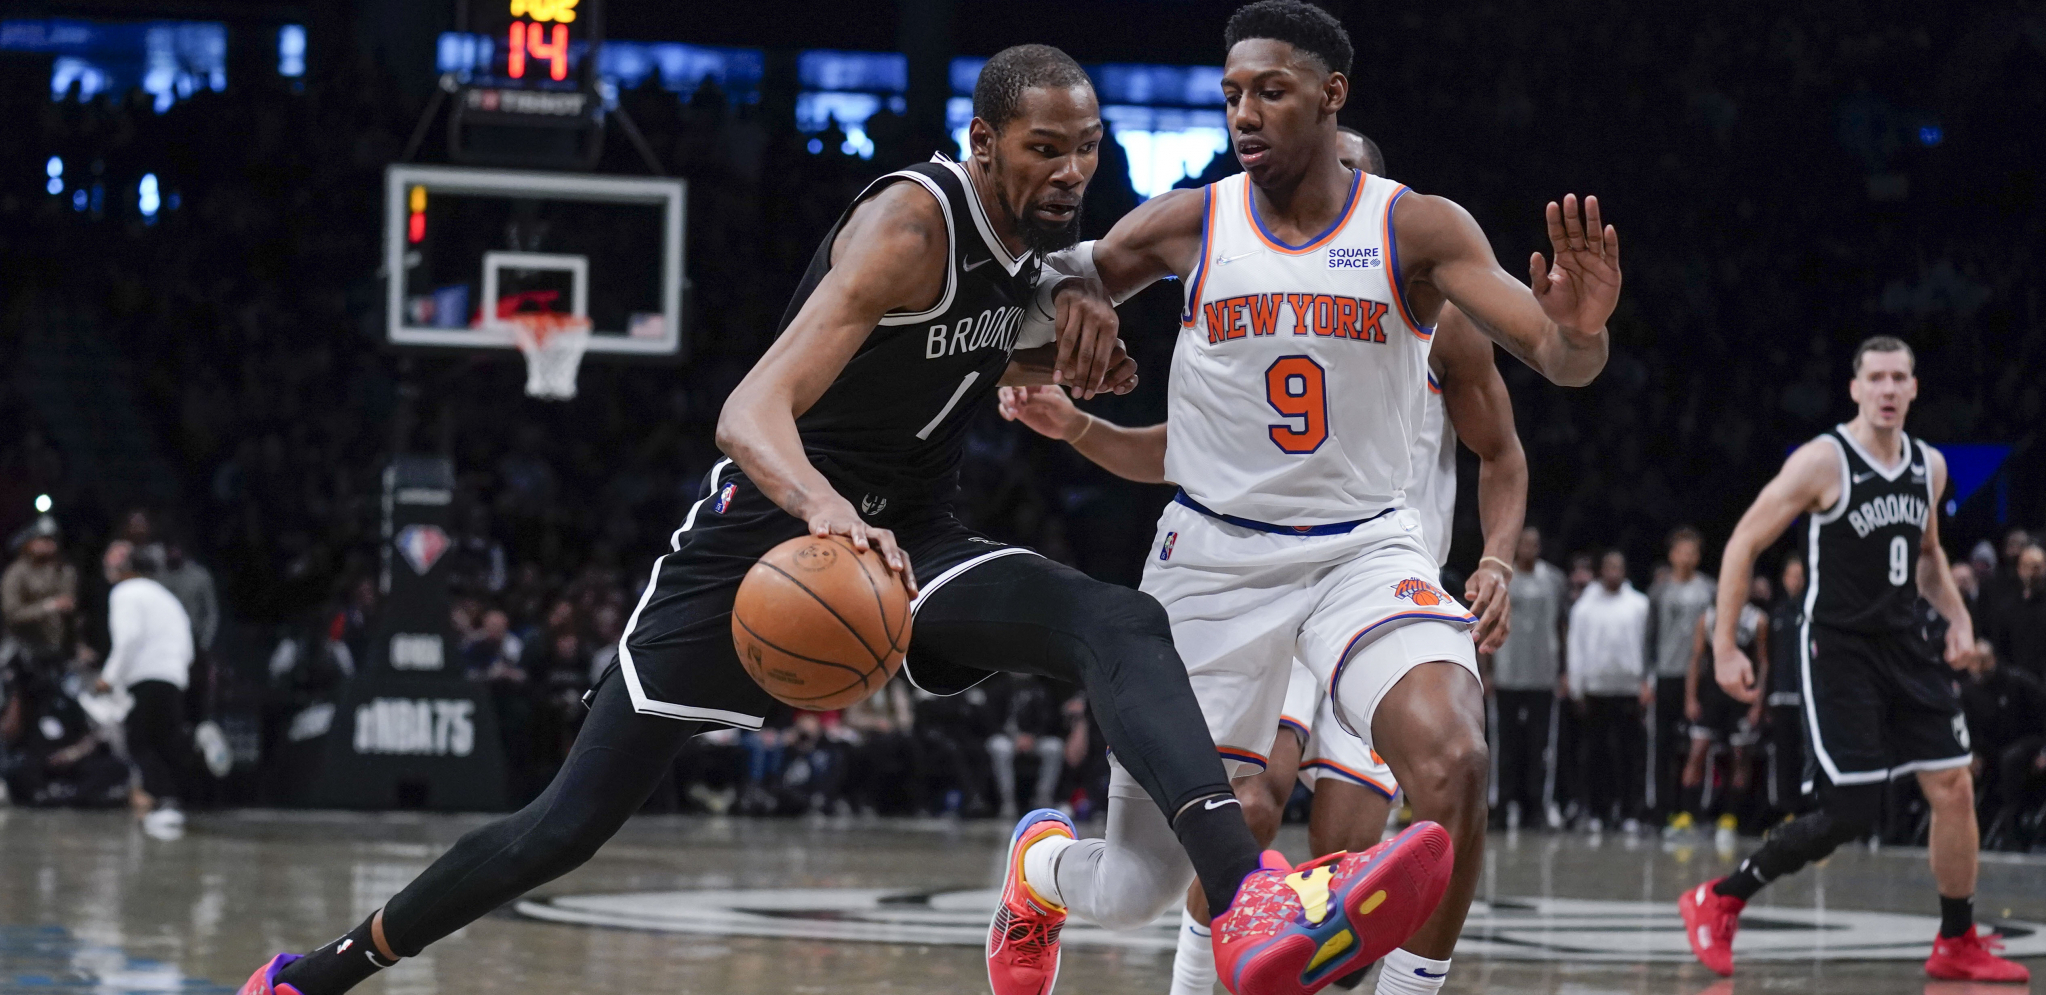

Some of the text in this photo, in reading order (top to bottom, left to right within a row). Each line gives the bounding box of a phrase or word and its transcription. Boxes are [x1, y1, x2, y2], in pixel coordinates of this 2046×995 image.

[508, 20, 568, 81] 14
[1328, 247, 1379, 258] SQUARE
[1328, 258, 1369, 268] SPACE
[1203, 292, 1389, 345] NEW YORK
[915, 370, 980, 441] 1
[1264, 355, 1329, 455] 9
[1888, 535, 1909, 587] 9
